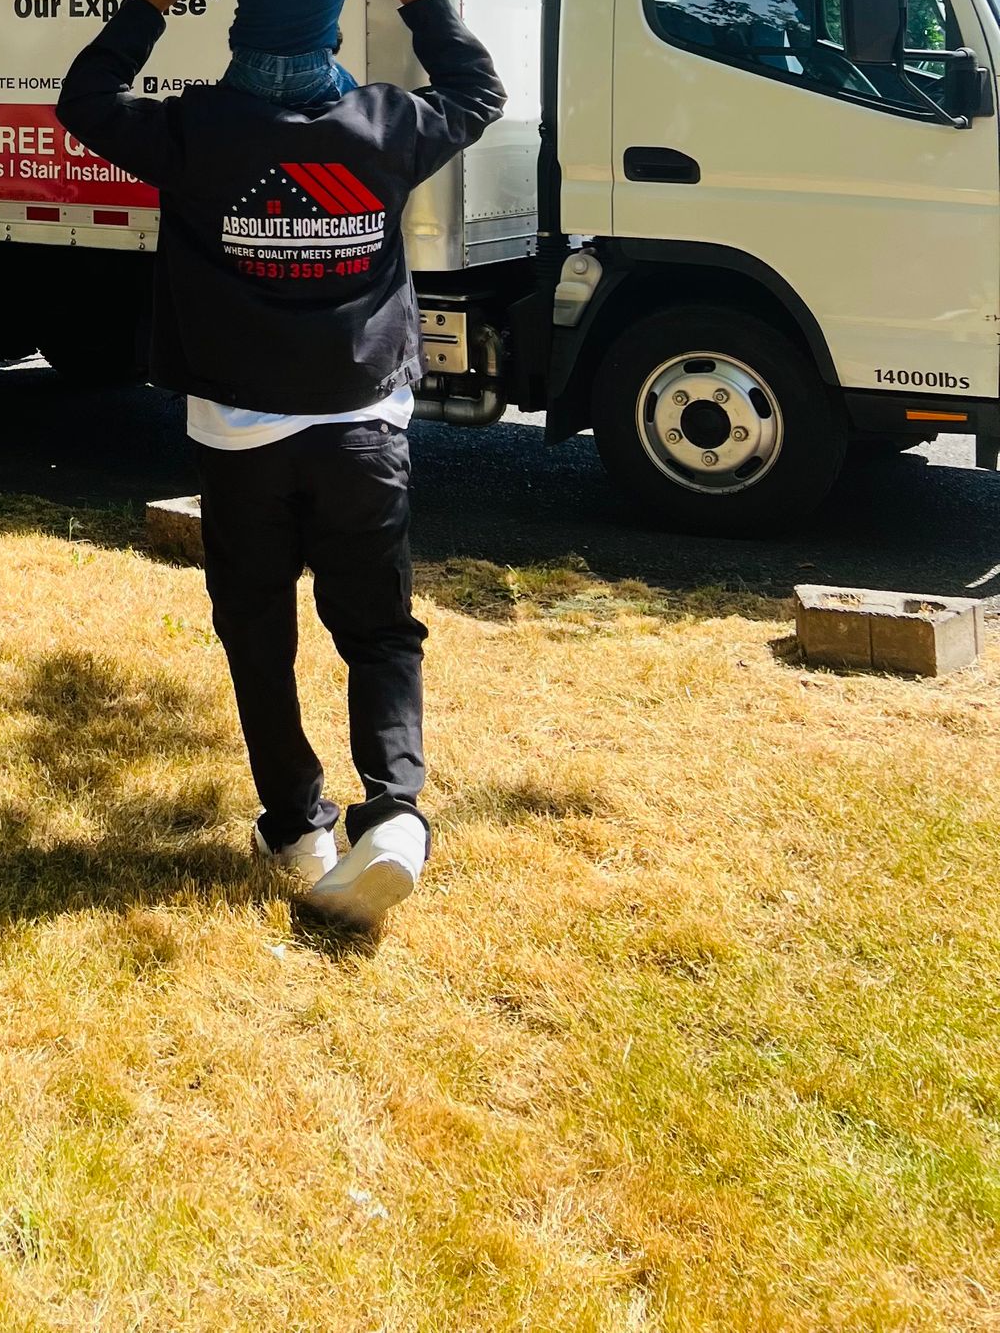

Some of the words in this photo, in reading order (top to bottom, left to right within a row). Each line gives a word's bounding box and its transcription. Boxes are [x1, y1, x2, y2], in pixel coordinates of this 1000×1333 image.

[64, 130, 100, 158] Q
[20, 160, 62, 179] Stair
[66, 161, 144, 183] Install
[222, 216, 292, 237] ABSOLUTE
[223, 245, 255, 258] WHERE
[258, 248, 300, 260] QUALITY
[301, 249, 332, 260] MEETS
[334, 240, 383, 258] PERFECTION
[874, 368, 970, 390] 14000lbs
